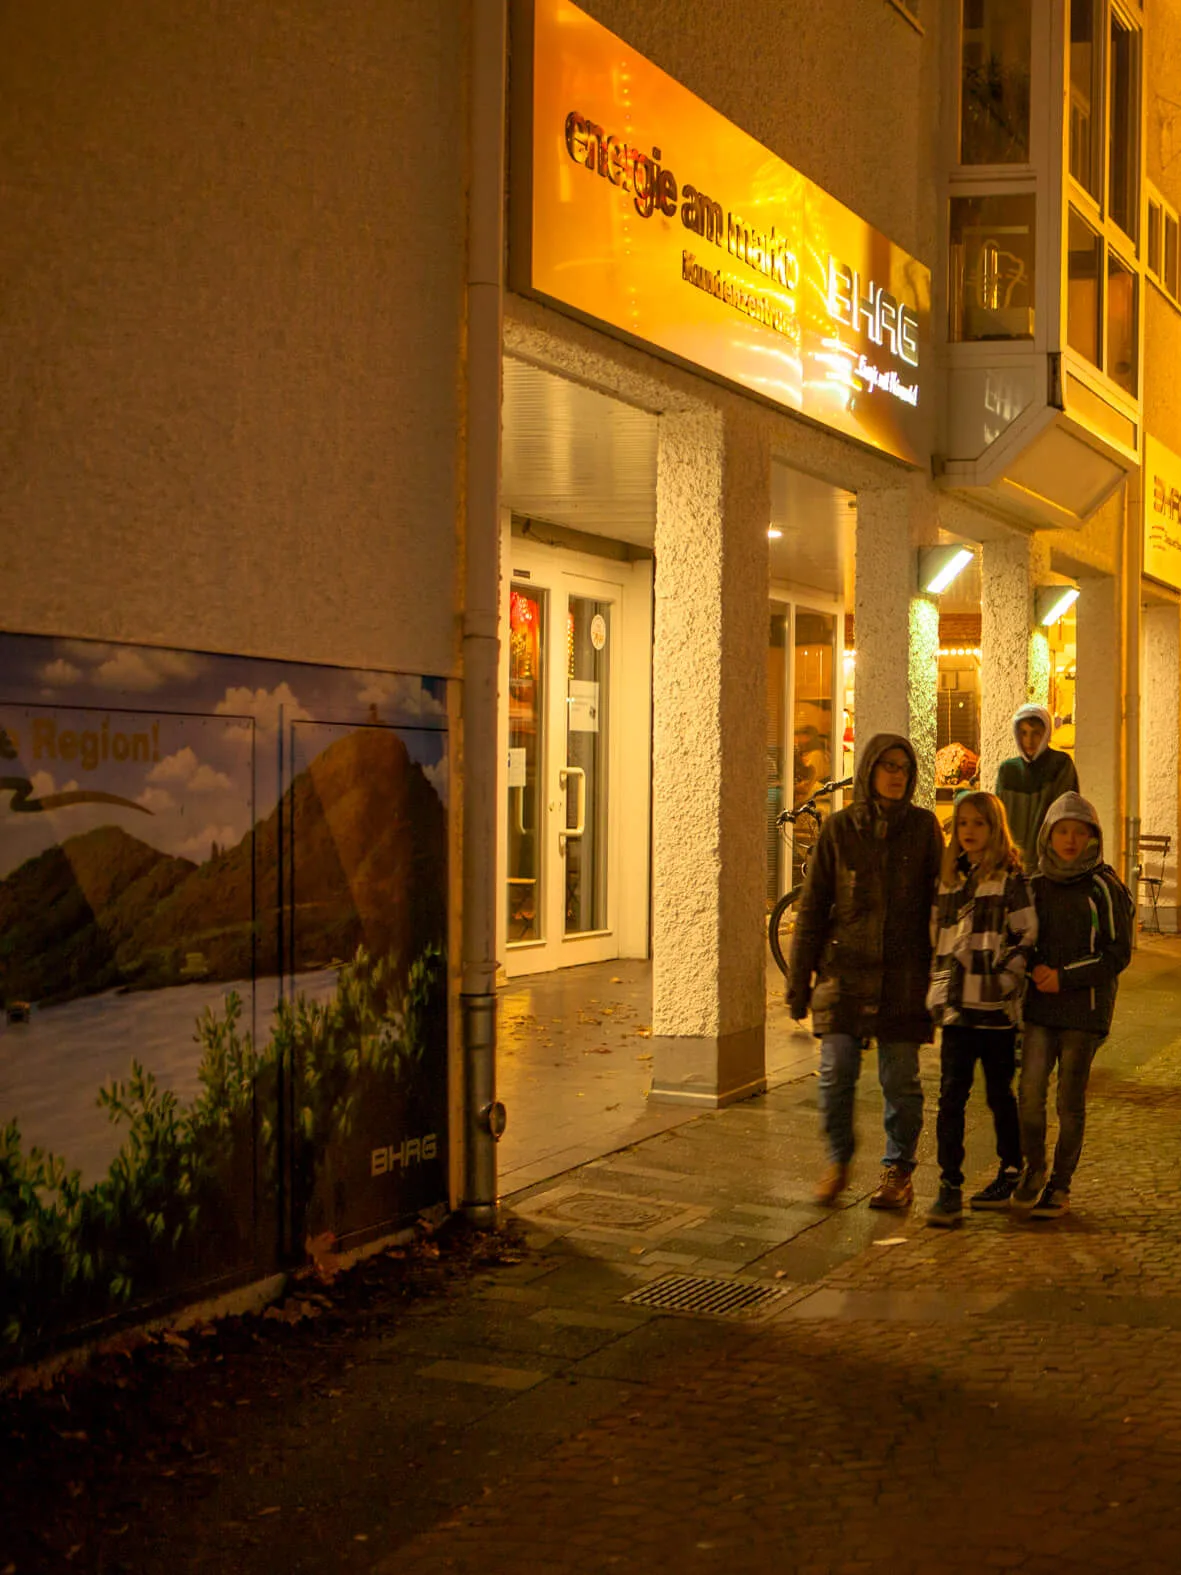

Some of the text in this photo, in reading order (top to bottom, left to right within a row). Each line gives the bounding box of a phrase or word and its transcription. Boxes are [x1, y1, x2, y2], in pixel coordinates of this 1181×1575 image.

[565, 111, 678, 219] energie
[680, 184, 723, 248] am
[33, 716, 160, 770] Region!
[371, 1133, 437, 1178] BHAG
